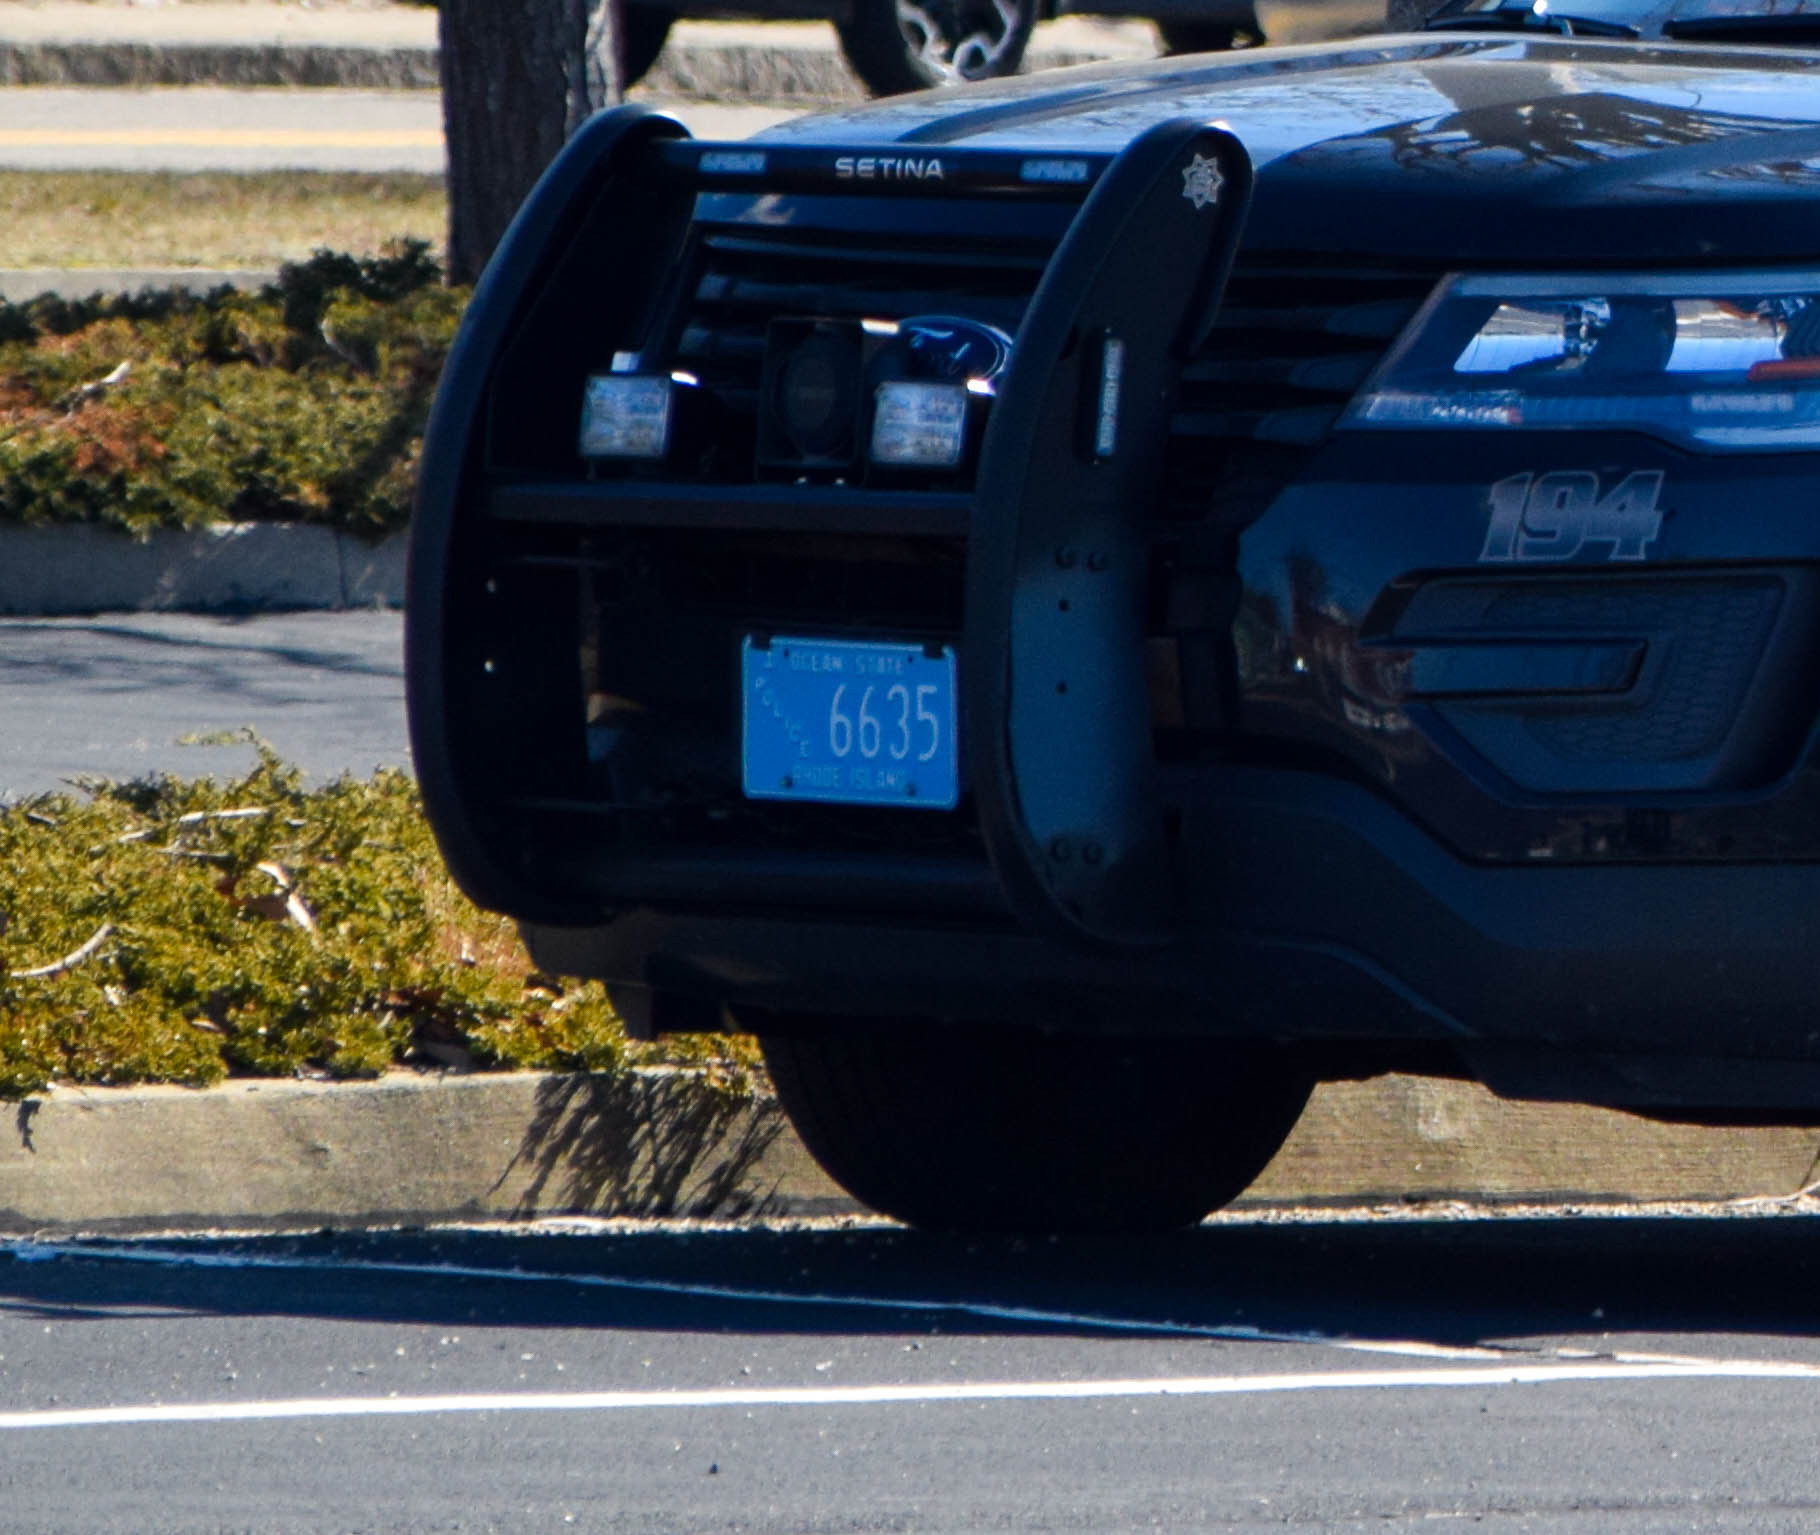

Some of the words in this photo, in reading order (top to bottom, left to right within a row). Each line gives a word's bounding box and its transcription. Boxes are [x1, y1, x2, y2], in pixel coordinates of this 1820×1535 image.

[834, 157, 945, 180] SETINA
[906, 326, 973, 377] Fd
[1475, 468, 1667, 562] 194
[789, 650, 843, 673] OCEAN
[854, 654, 904, 676] STATE
[828, 682, 940, 762] 6635
[791, 764, 842, 789] RHODE
